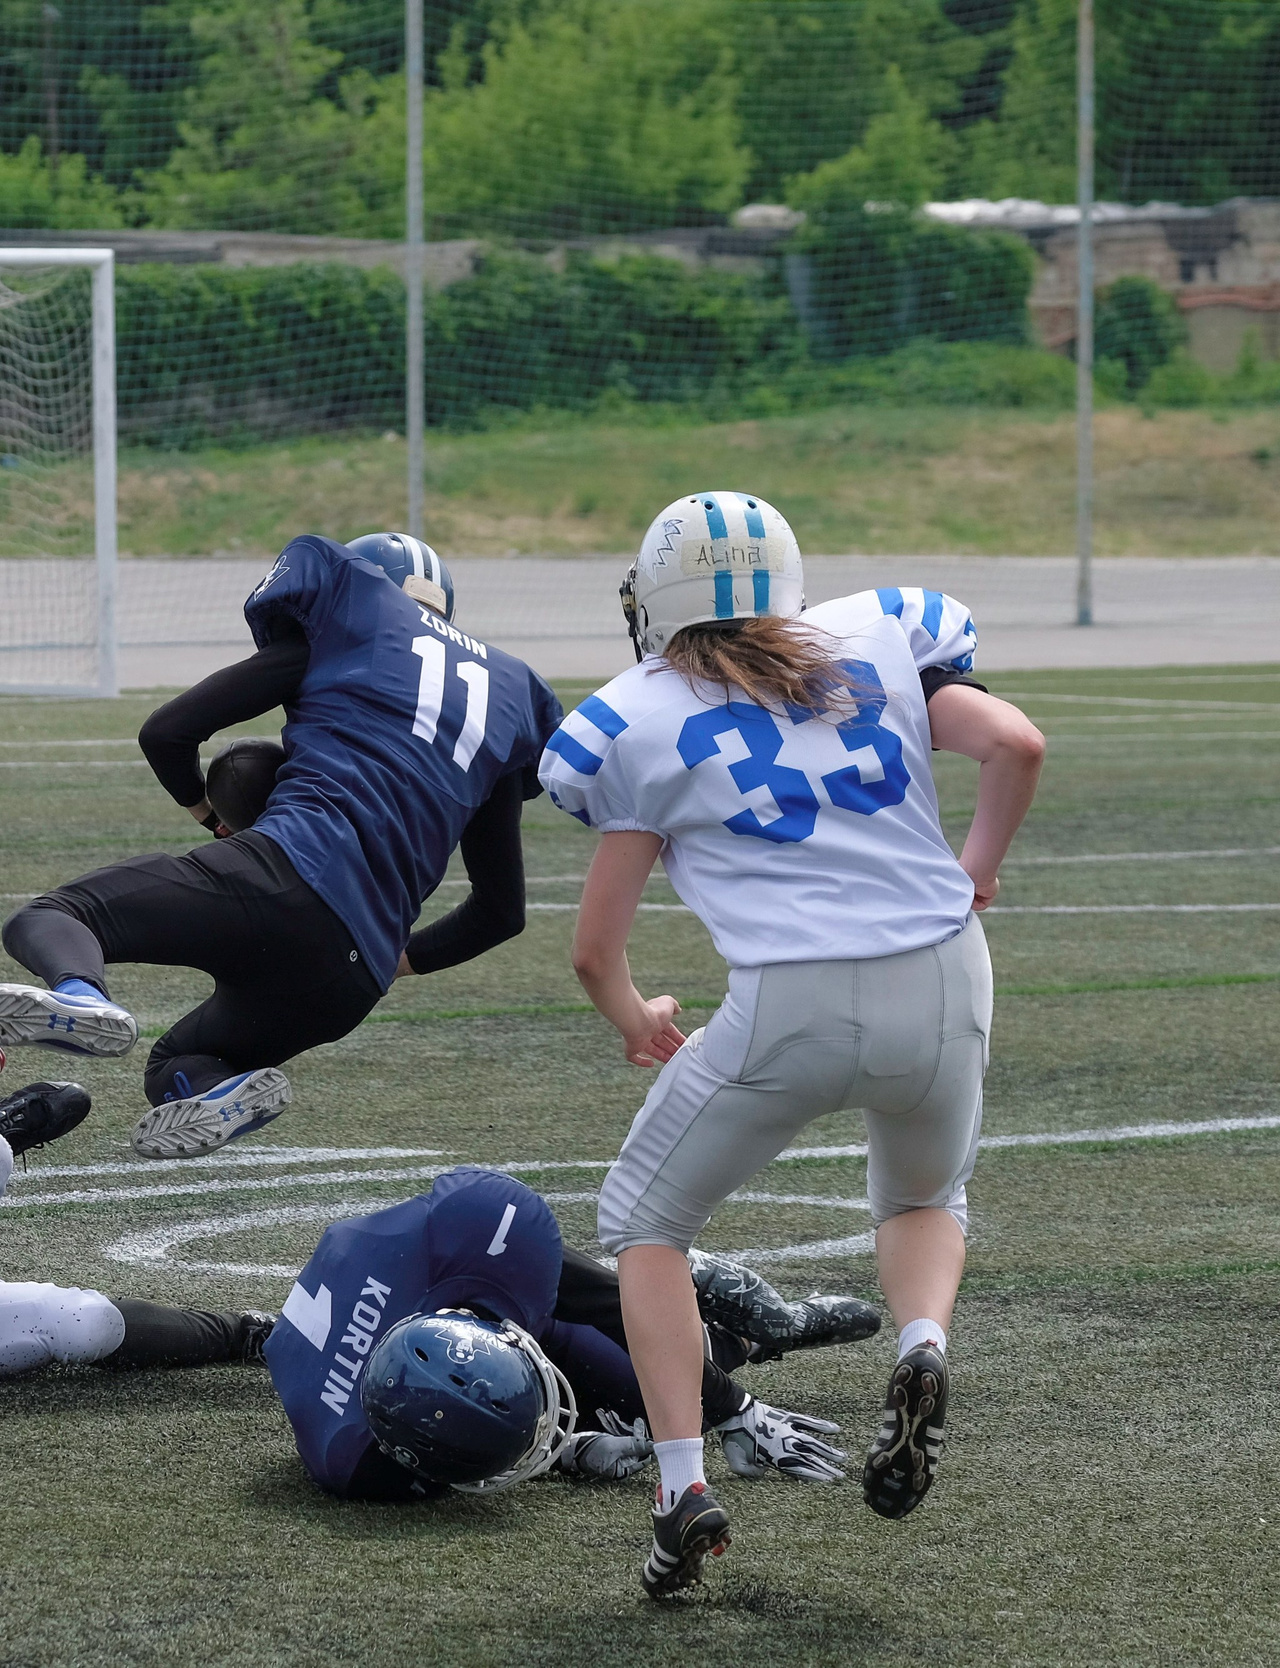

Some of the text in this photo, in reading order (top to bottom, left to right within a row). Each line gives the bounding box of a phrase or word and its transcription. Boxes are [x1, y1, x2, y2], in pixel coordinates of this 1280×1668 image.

[417, 605, 488, 660] ZORIN
[411, 635, 490, 773] 11
[676, 658, 911, 844] 33
[486, 1203, 517, 1256] 1
[320, 1276, 392, 1417] KORTIN
